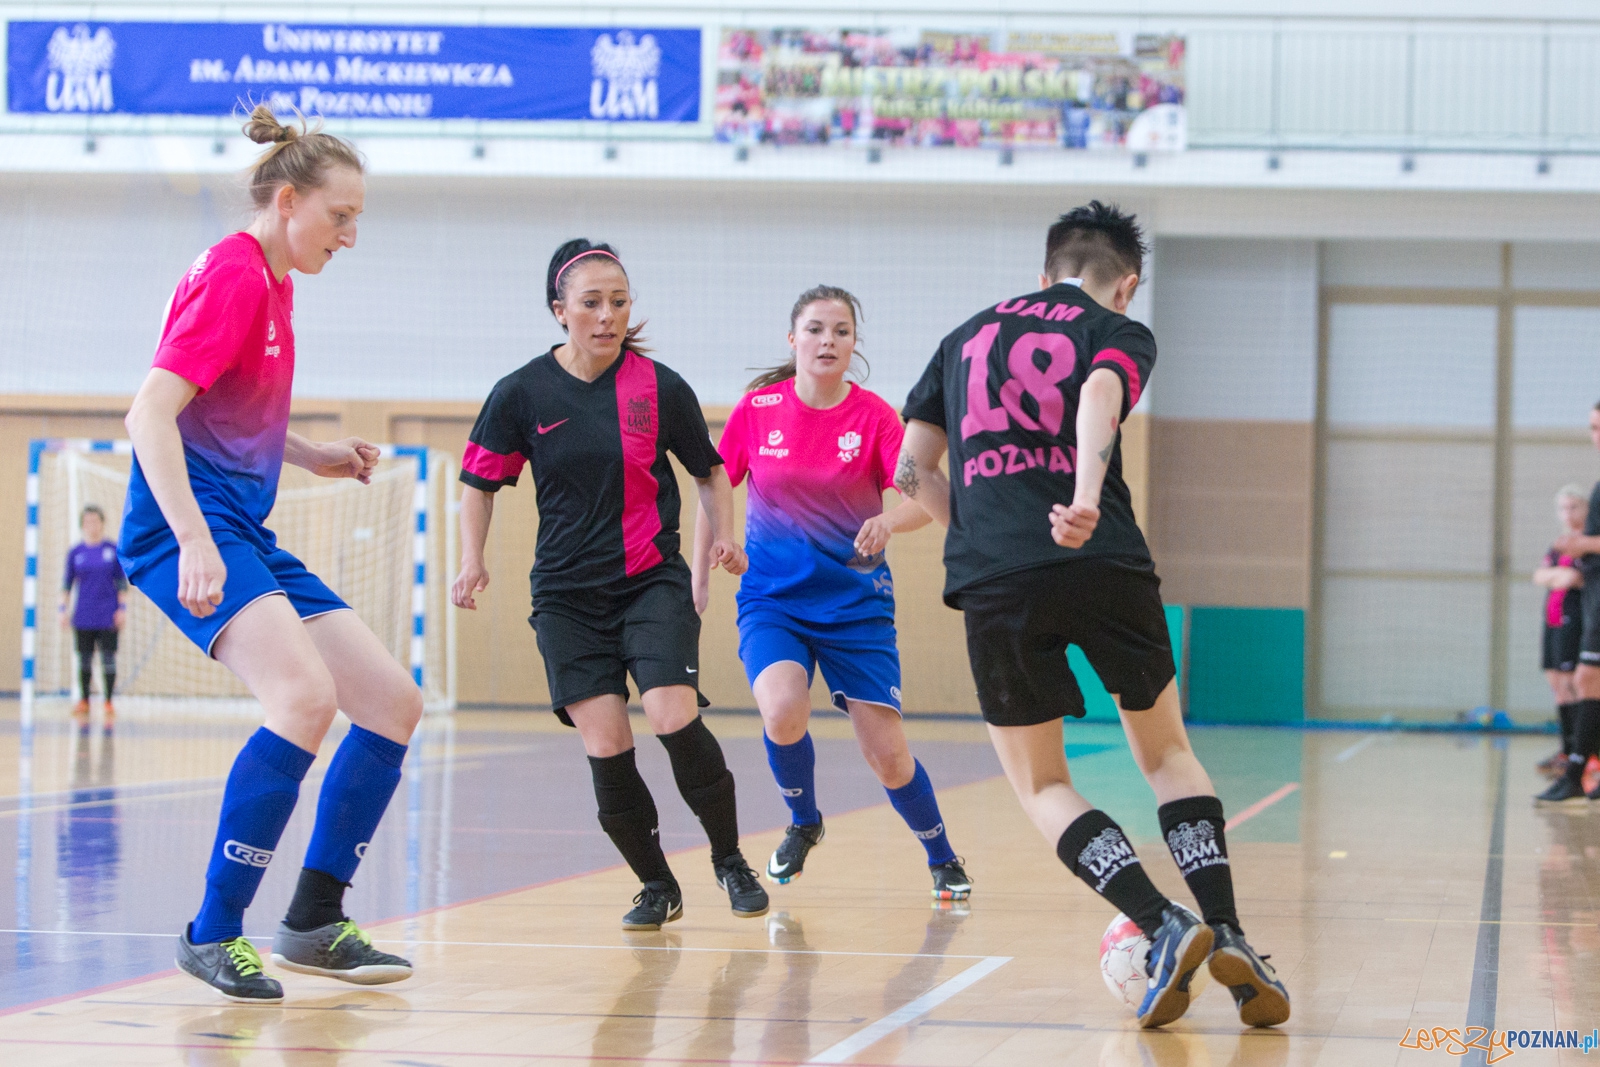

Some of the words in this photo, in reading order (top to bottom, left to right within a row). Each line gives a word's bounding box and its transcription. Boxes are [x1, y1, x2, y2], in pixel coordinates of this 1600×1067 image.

[46, 73, 114, 112] UAM
[300, 86, 433, 116] POZNANIU
[590, 79, 658, 119] UAM
[995, 298, 1085, 322] UAM
[960, 321, 1077, 442] 18
[627, 414, 651, 427] UAM
[759, 446, 789, 459] Energa
[1088, 840, 1133, 877] UAM
[1173, 839, 1220, 867] UAM
